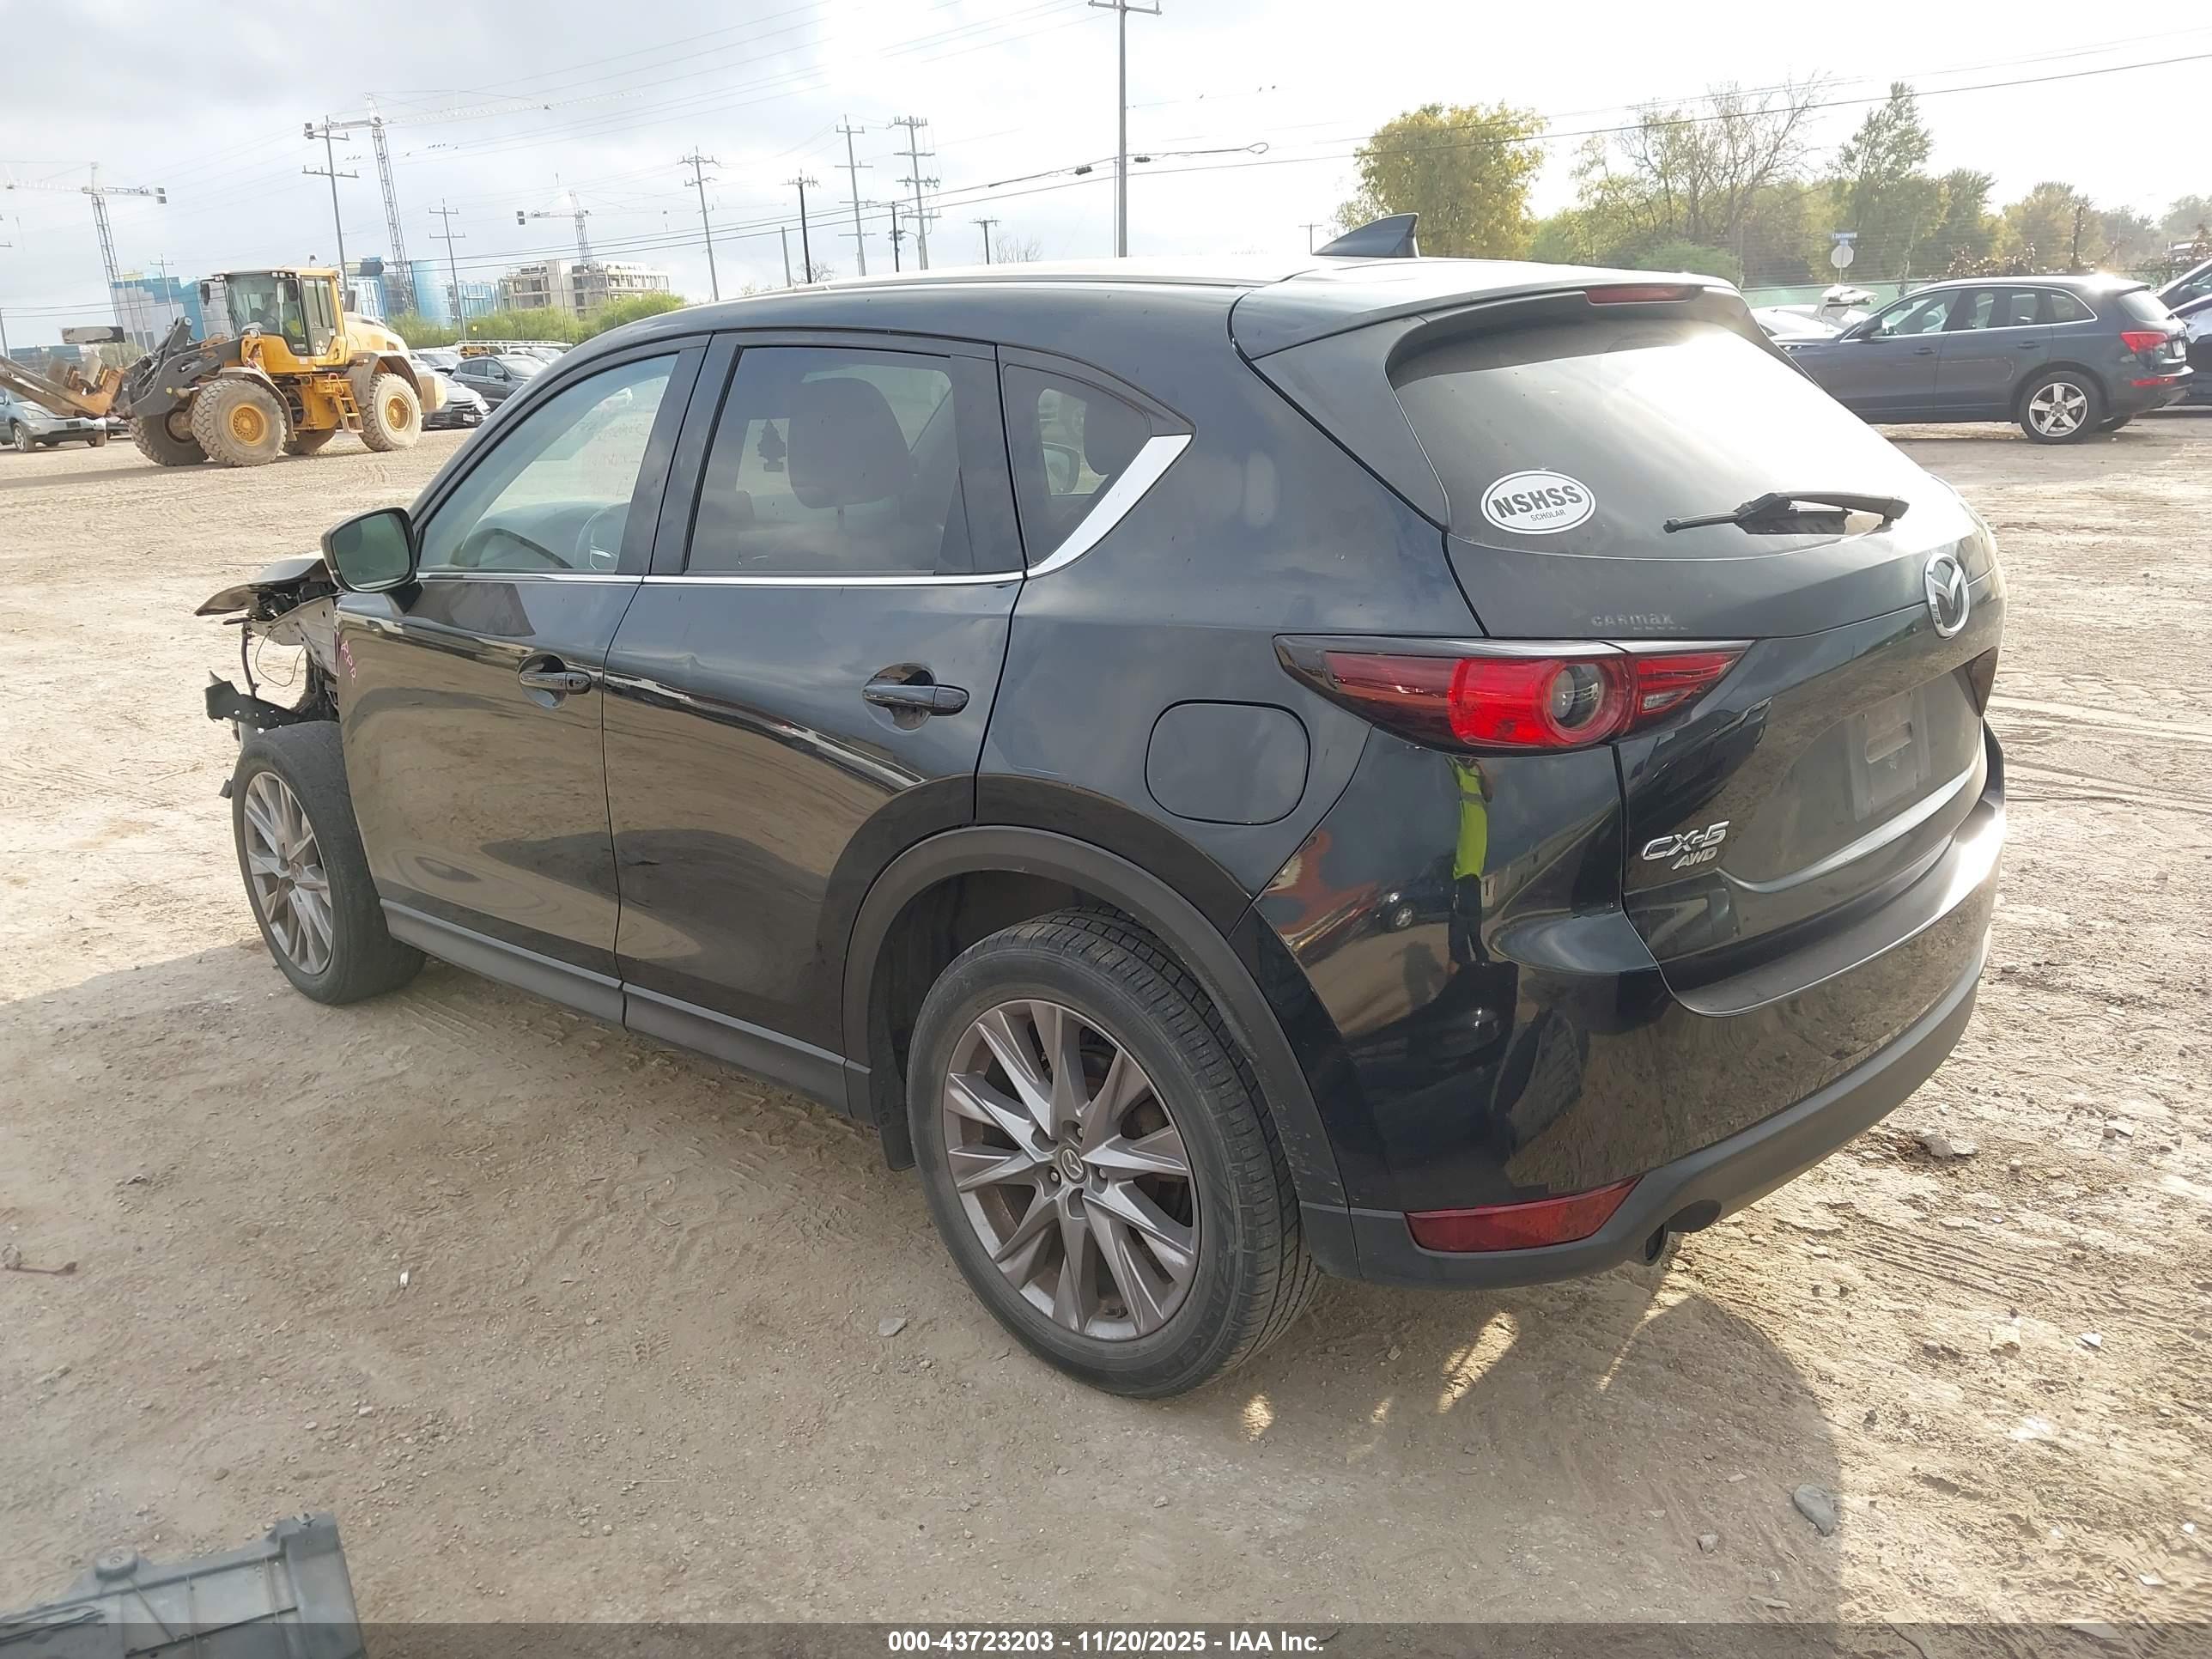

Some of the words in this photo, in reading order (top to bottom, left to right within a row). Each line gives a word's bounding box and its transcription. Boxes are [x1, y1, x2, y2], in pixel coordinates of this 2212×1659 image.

[1492, 485, 1583, 519] NSHSS
[1530, 509, 1567, 522] SCHOLAR
[1641, 819, 1730, 861] CX-5
[1671, 846, 1718, 872] AWD
